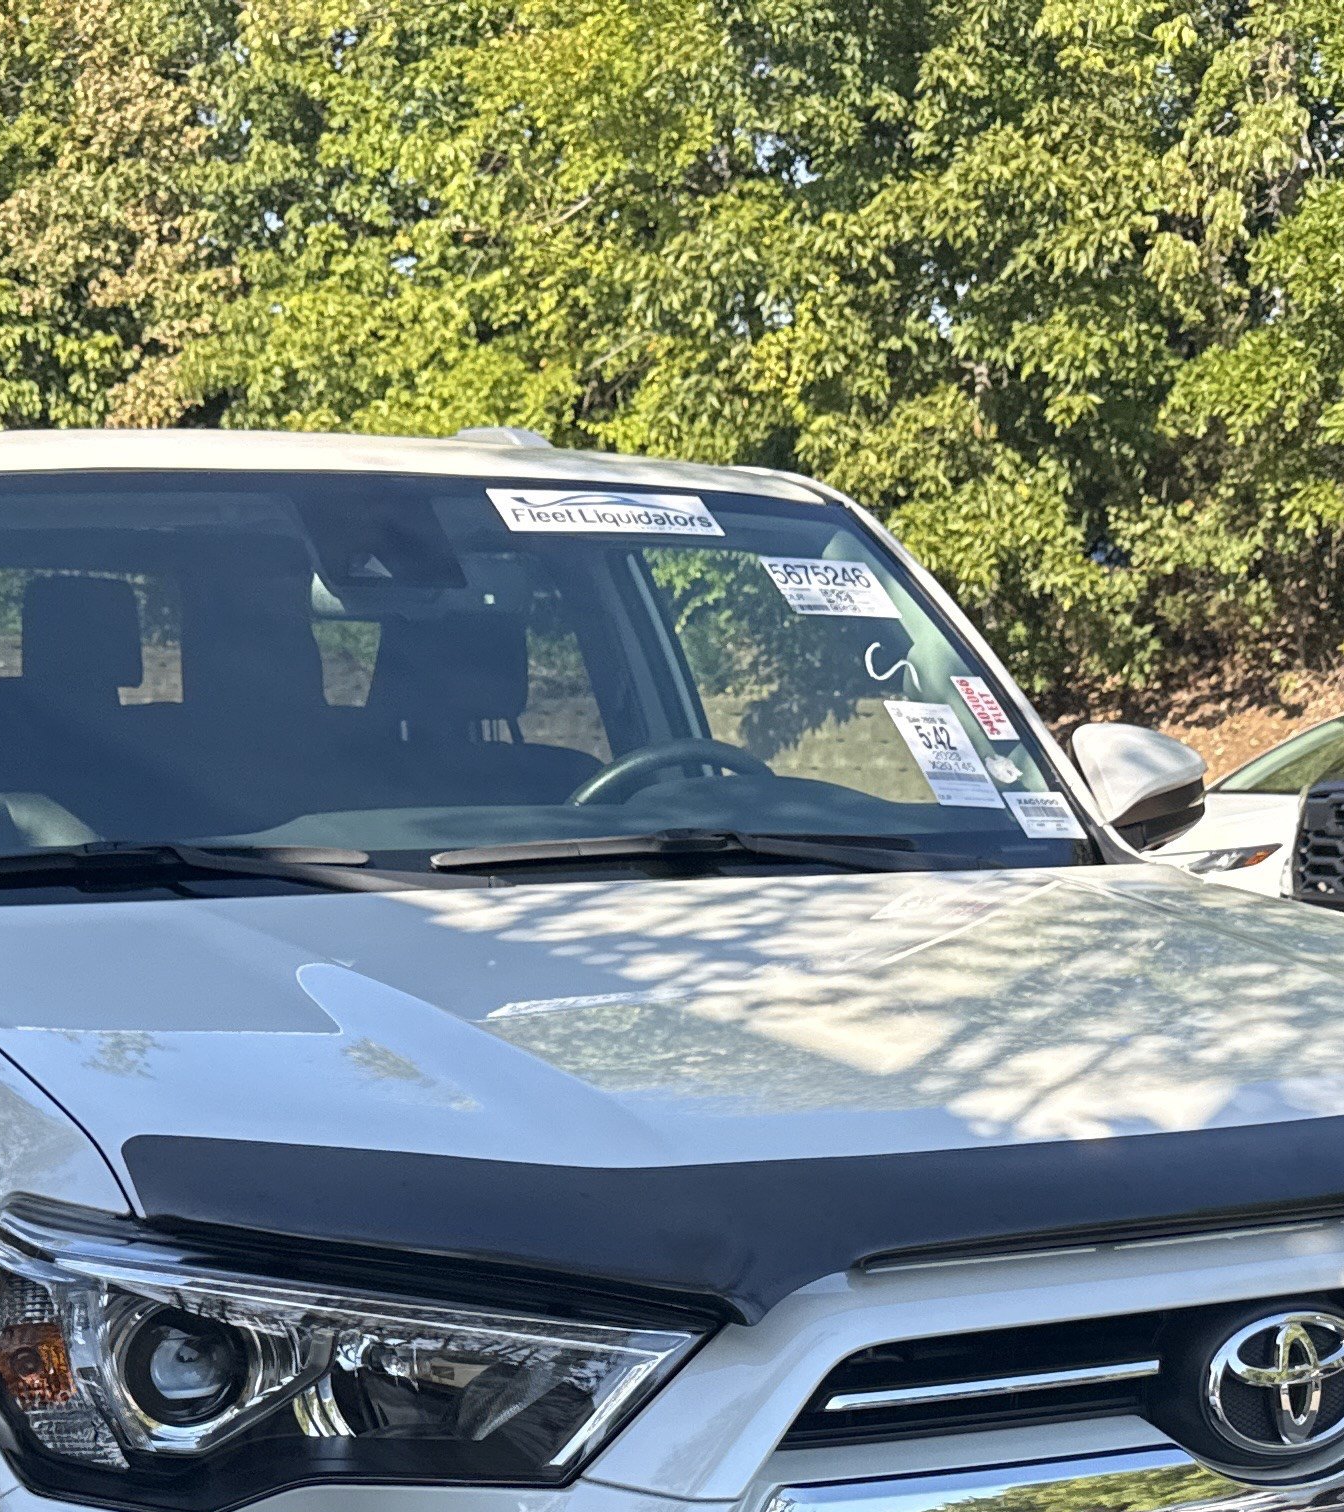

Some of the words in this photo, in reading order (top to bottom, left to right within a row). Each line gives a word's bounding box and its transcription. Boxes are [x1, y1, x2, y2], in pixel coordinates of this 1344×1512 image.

[510, 508, 576, 523] Fleet
[581, 509, 713, 529] Liquidators
[767, 563, 871, 588] 5675246
[914, 725, 958, 751] 5:42
